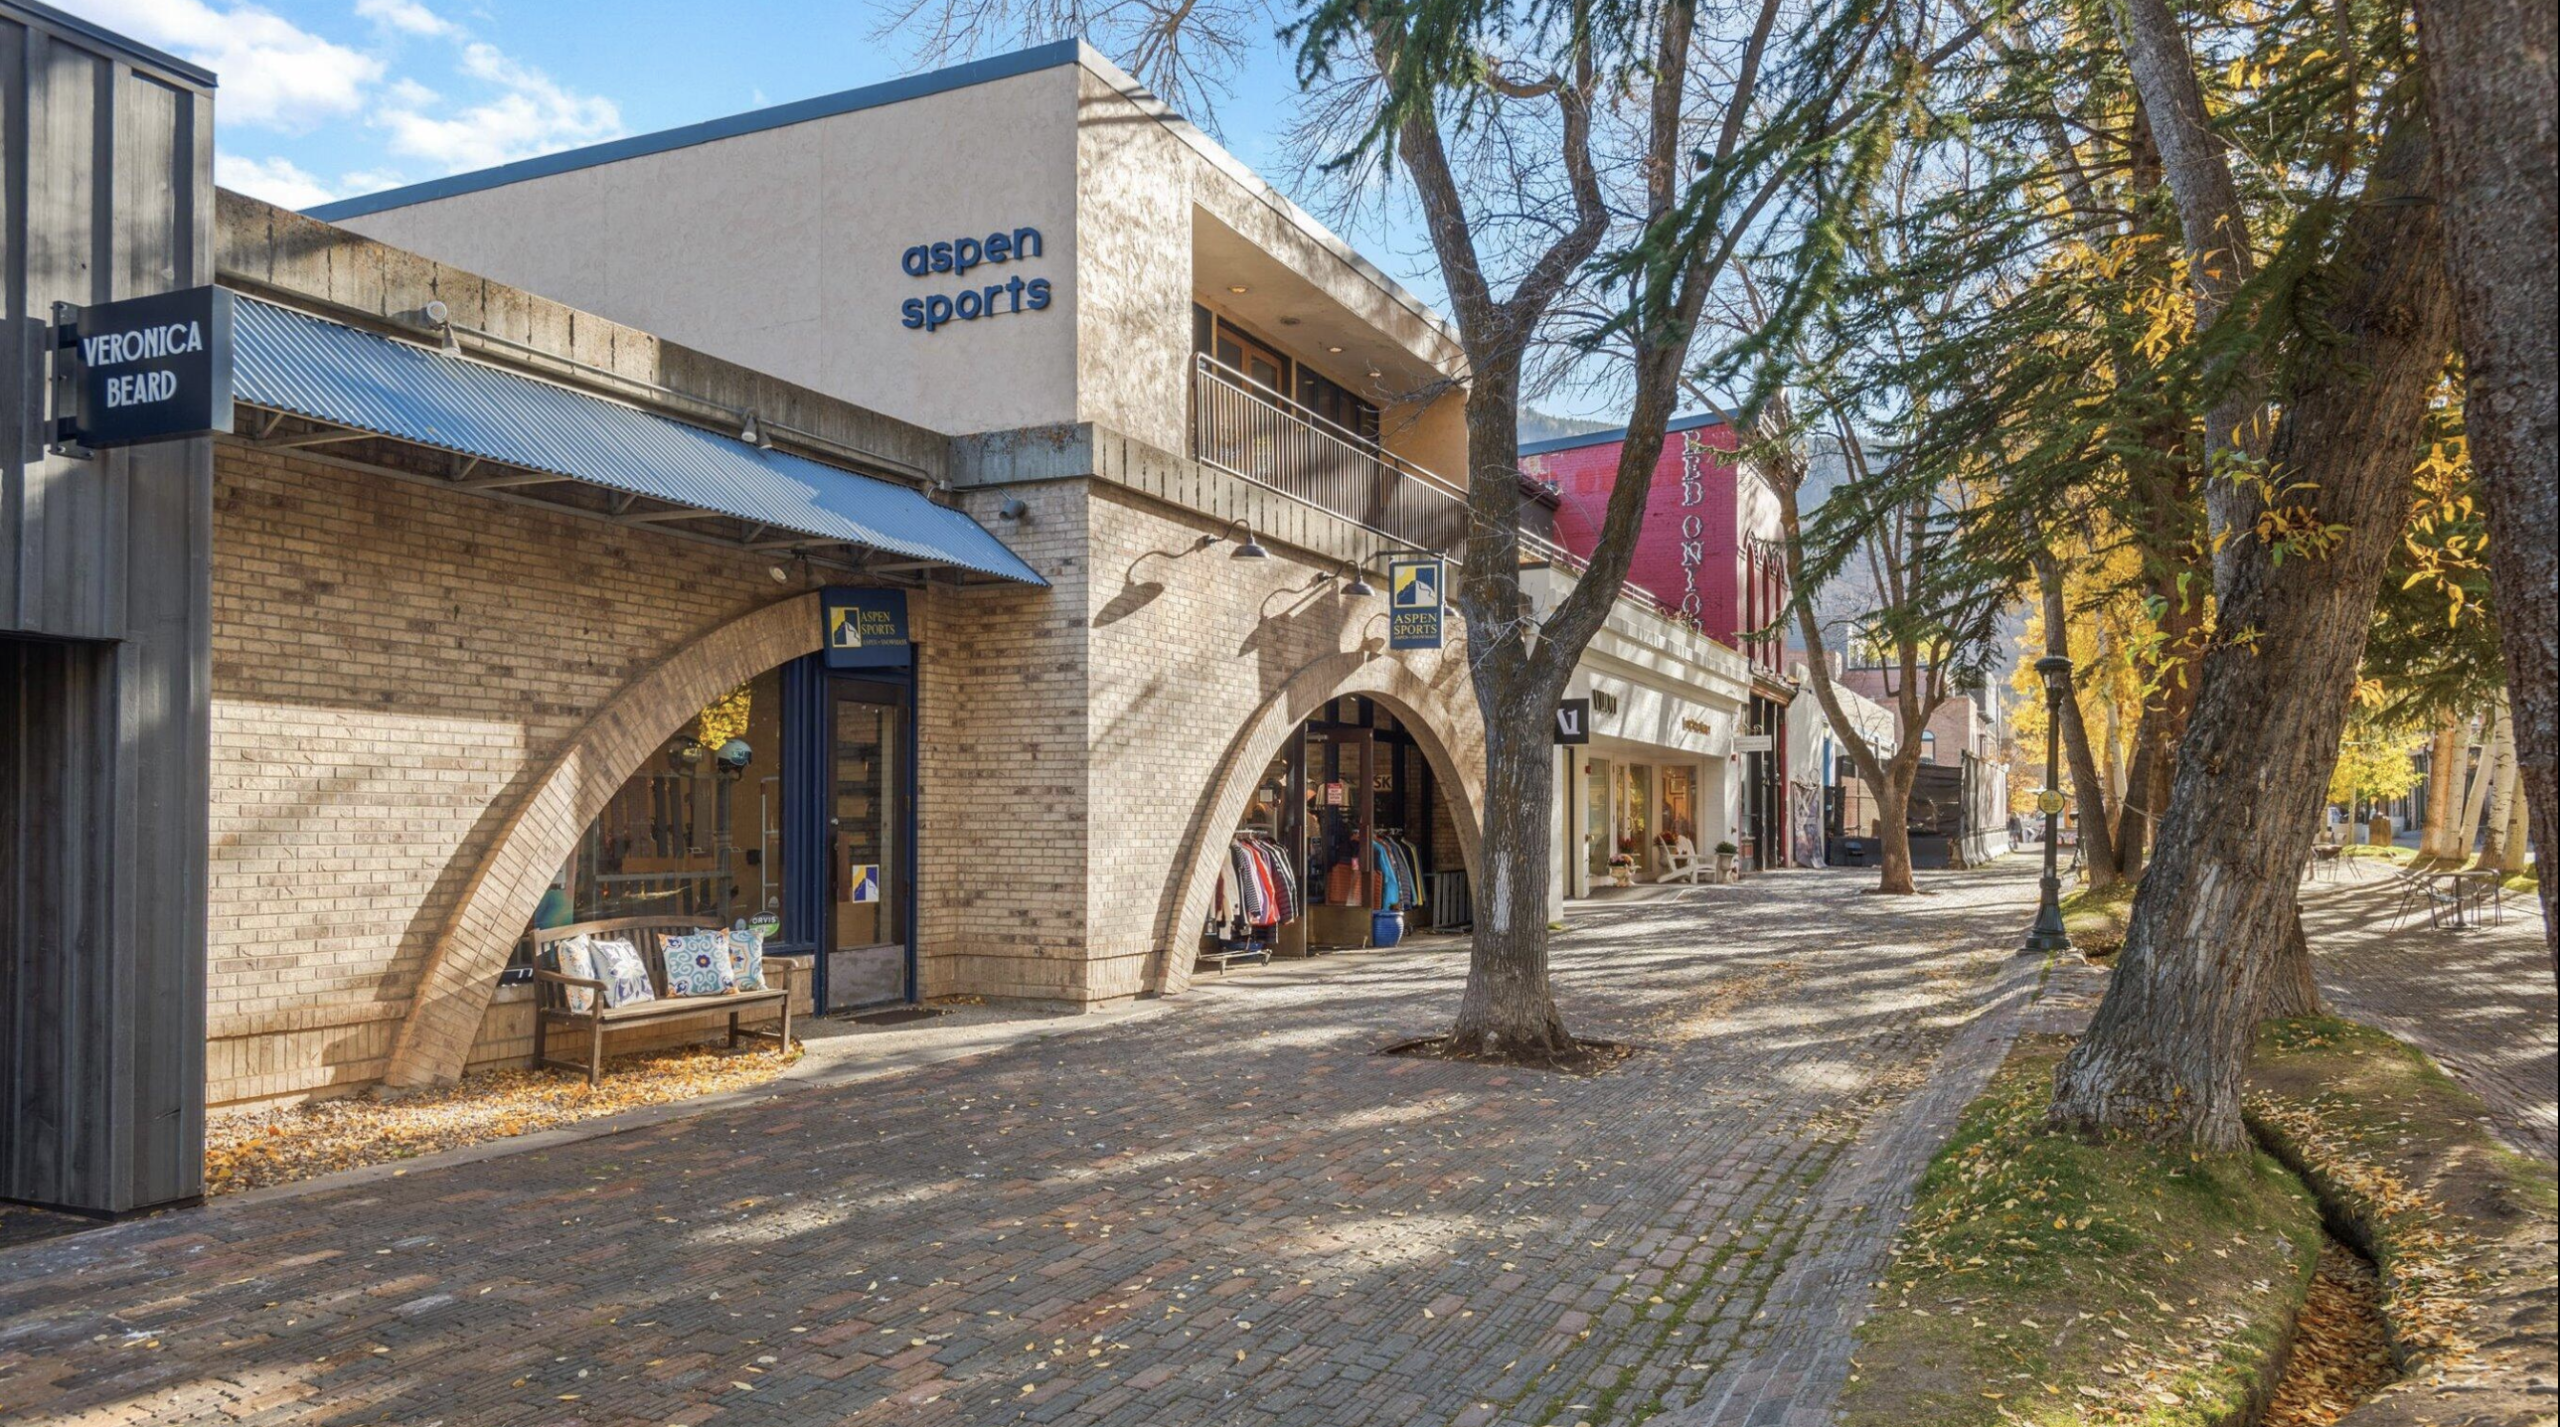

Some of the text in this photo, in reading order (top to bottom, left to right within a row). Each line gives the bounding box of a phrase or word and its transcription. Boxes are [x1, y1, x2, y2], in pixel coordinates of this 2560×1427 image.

[901, 225, 1044, 277] aspen
[901, 275, 1052, 332] sports
[83, 320, 203, 367] VERONICA
[107, 370, 178, 408] BEARD
[1681, 430, 1704, 506] RED
[861, 611, 891, 622] ASPEN
[861, 623, 896, 635] SPORTS
[1394, 613, 1437, 624] ASPEN
[1393, 624, 1438, 635] SPORTS
[752, 916, 777, 925] ORVIS
